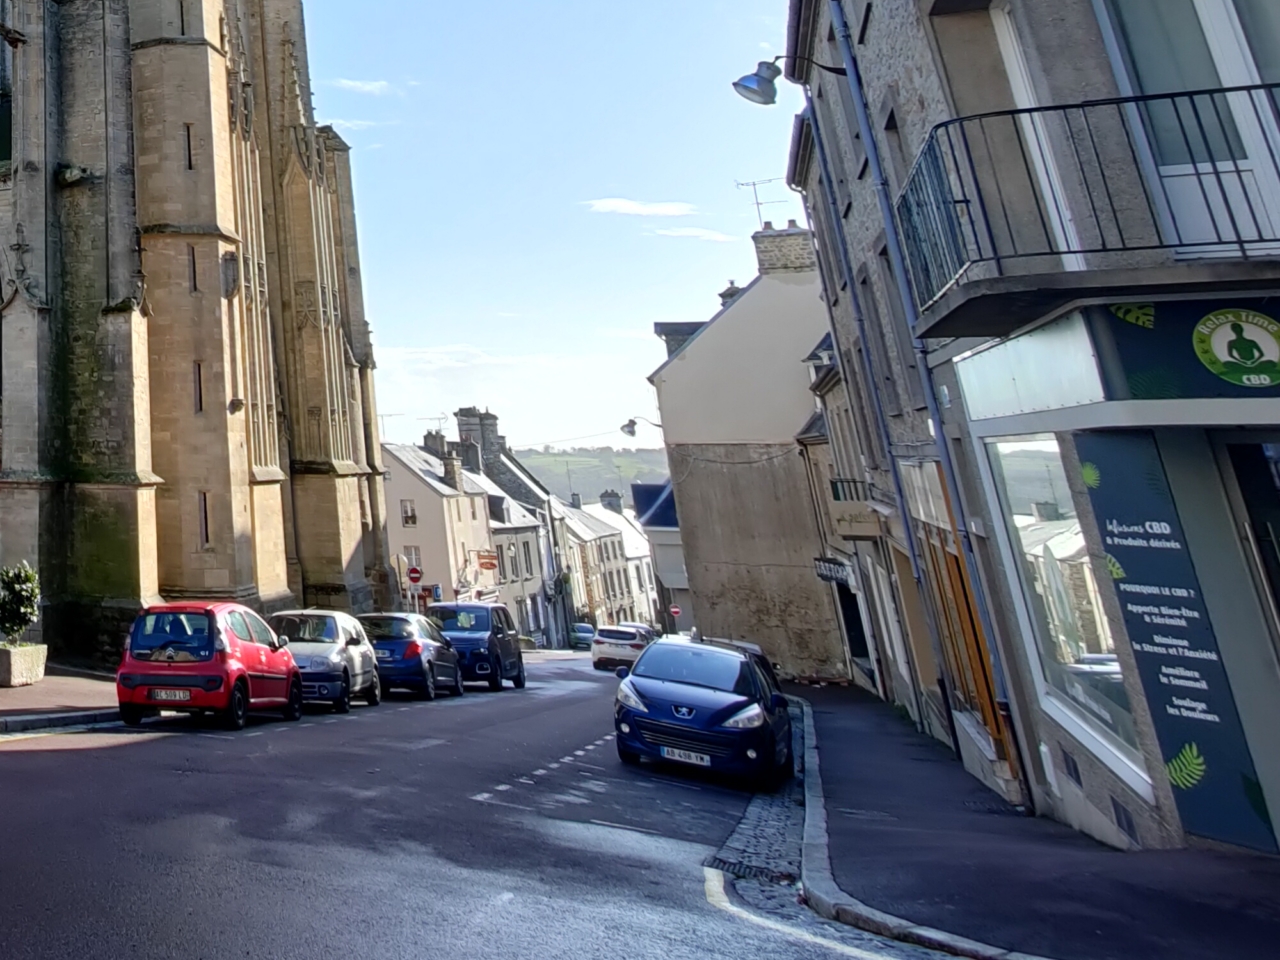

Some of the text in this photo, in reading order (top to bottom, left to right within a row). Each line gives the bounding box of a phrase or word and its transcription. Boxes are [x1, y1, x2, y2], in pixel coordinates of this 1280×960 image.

[1198, 311, 1279, 335] Relax Time
[1242, 374, 1271, 385] CBD
[1144, 521, 1171, 534] CBD
[1113, 537, 1148, 547] Produits
[1149, 538, 1181, 549] dérivés
[1119, 583, 1160, 595] POURQUOI
[1160, 586, 1171, 596] LE
[1171, 588, 1188, 597] CBD
[1127, 603, 1200, 618] Apporte Bien-Être
[1151, 615, 1187, 627] Sérénité
[1153, 634, 1189, 647] Diminue
[1132, 641, 1141, 651] le
[1142, 643, 1167, 654] Stress
[1168, 646, 1178, 655] et
[1161, 665, 1200, 678] Améliore
[1169, 676, 1208, 690] Sommeil
[1172, 696, 1208, 711] Soulage
[1180, 707, 1220, 722] Douleurs
